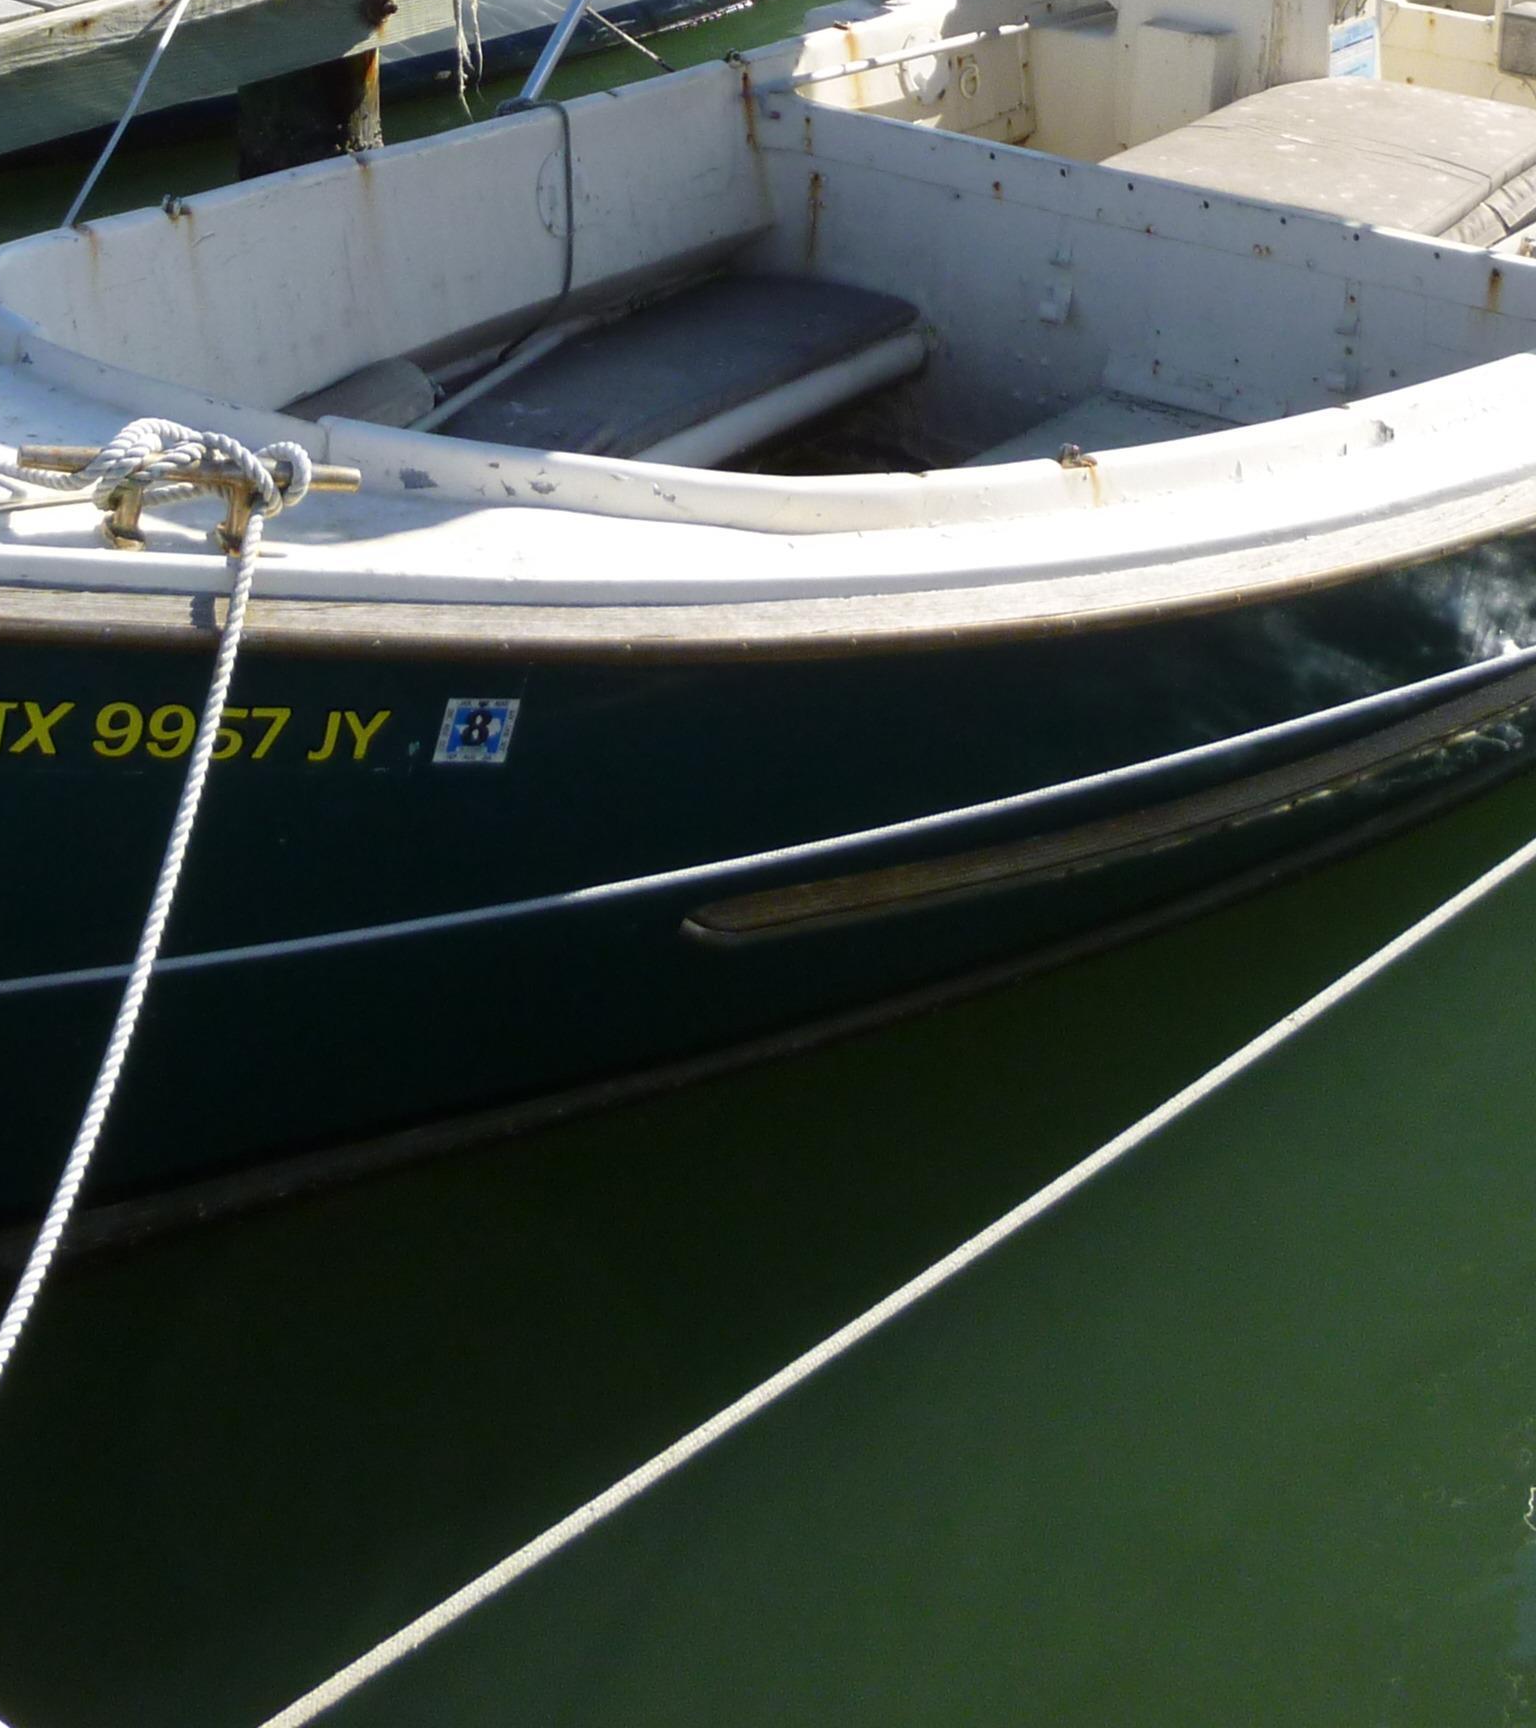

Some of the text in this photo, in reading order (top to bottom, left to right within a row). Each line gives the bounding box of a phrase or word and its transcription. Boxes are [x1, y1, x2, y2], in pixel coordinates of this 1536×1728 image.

[91, 701, 292, 760] 9957
[307, 708, 391, 762] JY
[461, 708, 492, 746] 8
